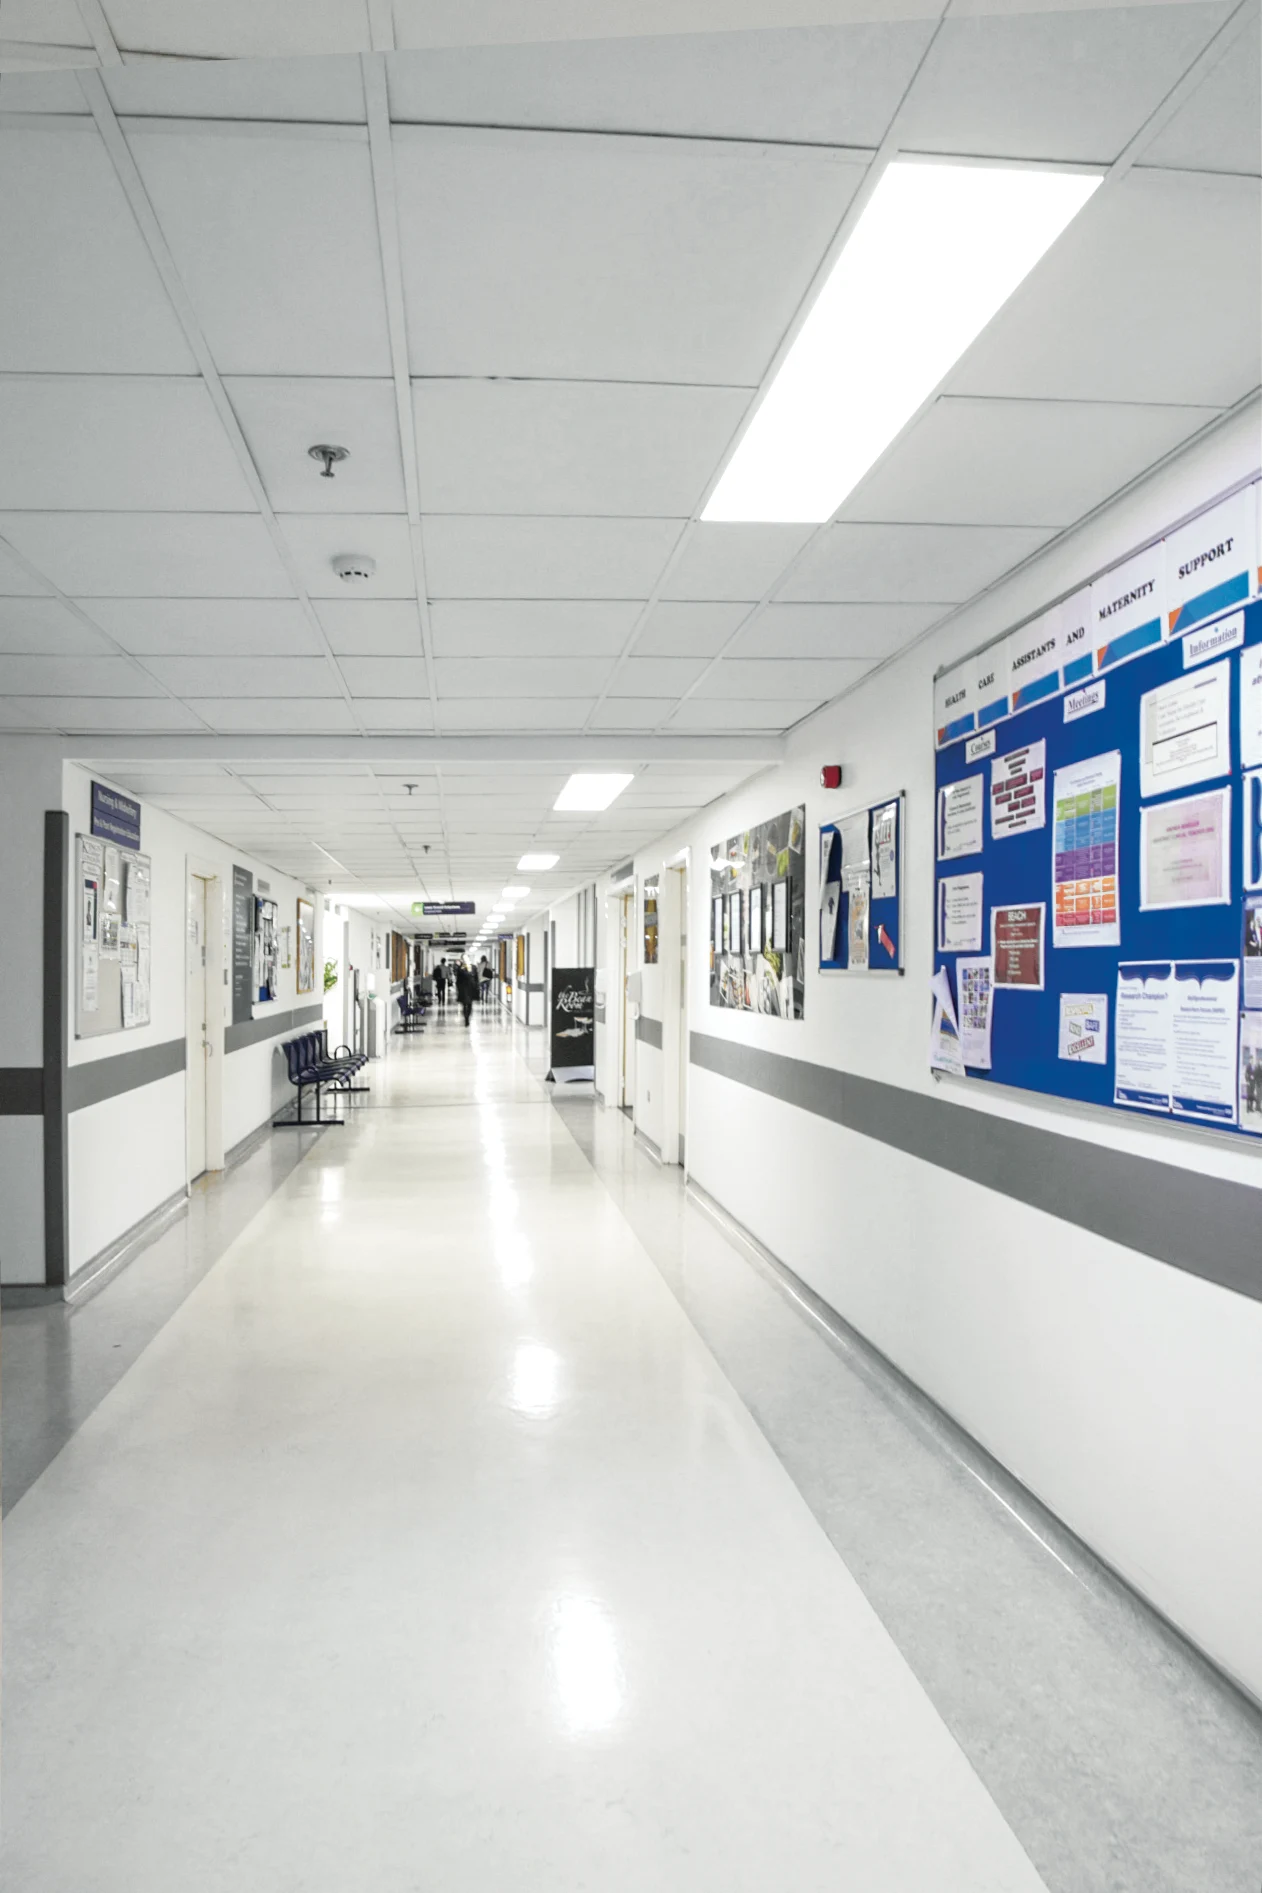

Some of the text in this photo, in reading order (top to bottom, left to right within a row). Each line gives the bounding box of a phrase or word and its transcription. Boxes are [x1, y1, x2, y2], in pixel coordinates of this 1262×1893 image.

[945, 537, 1234, 708] HEALTH CARE ASSISTANTS AND MATERNITY SUPPORT
[1189, 627, 1238, 657] Information
[1067, 691, 1099, 713] Meetings
